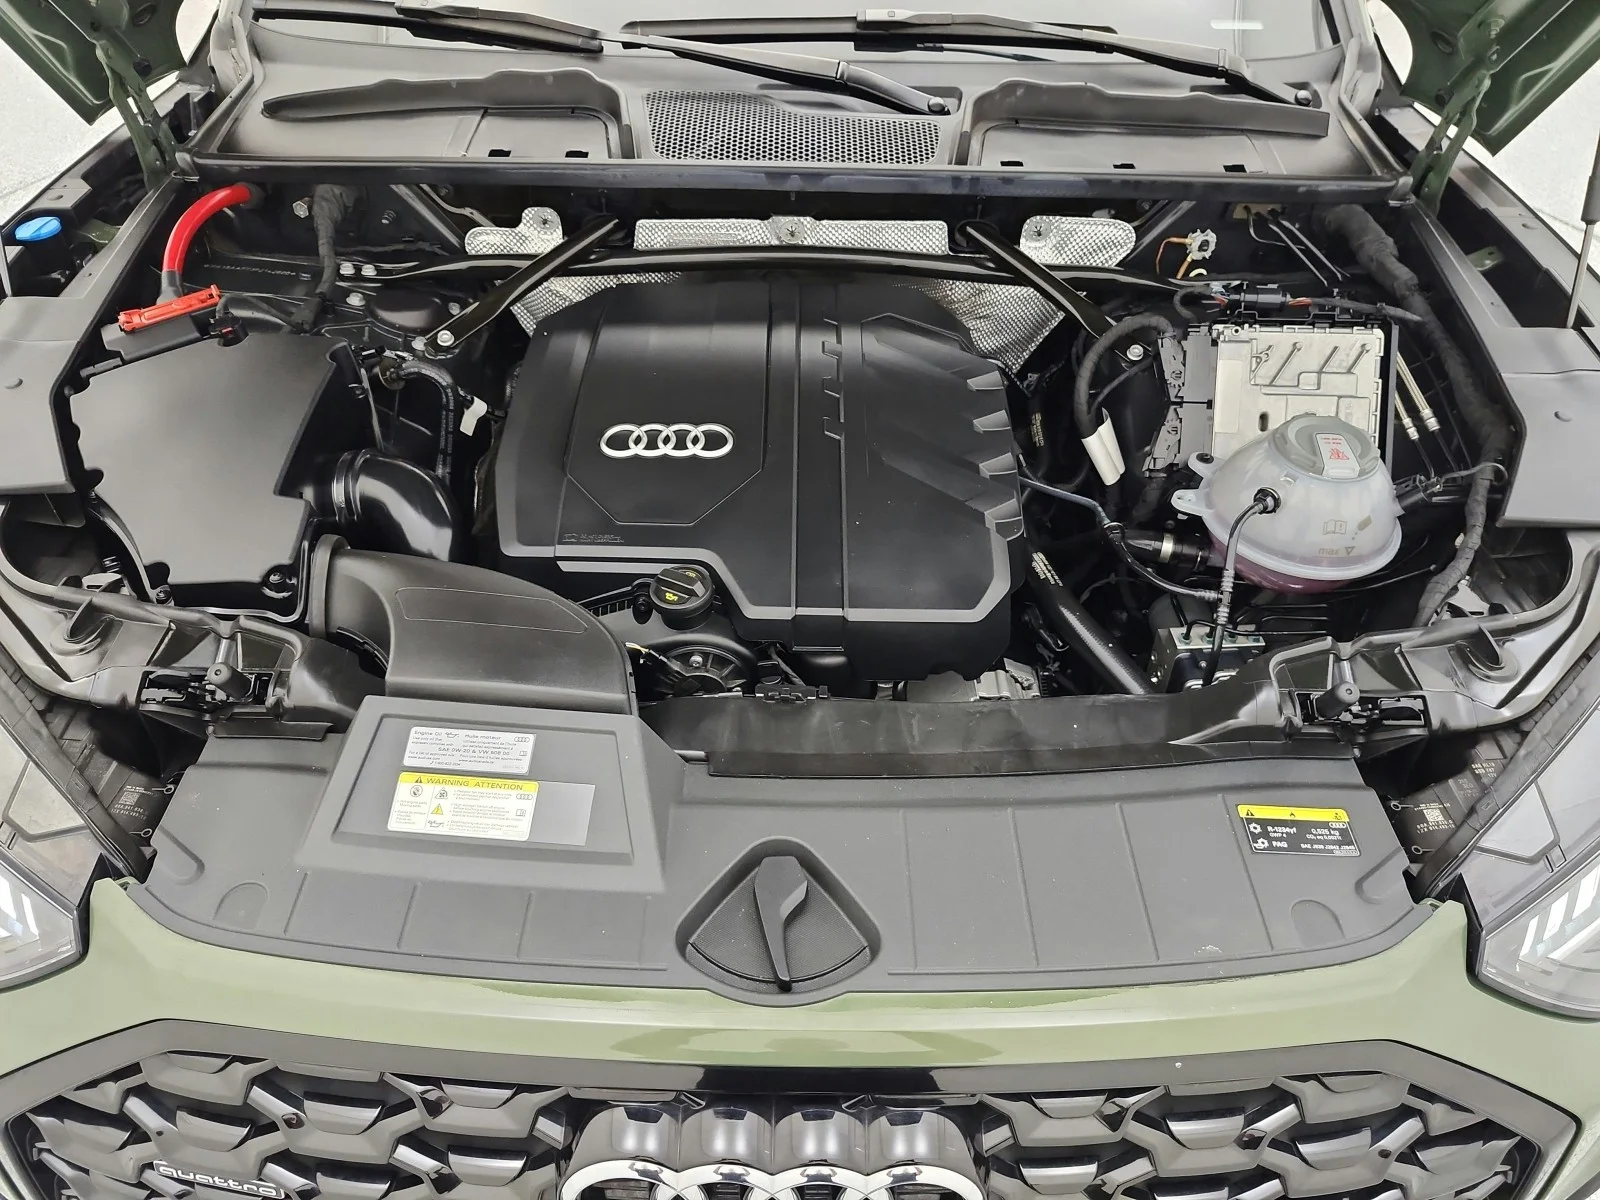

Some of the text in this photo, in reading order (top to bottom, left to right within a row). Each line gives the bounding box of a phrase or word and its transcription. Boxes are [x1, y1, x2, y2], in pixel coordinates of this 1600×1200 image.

[1318, 546, 1340, 556] max
[426, 777, 469, 787] WARNING
[474, 781, 523, 790] ATTENTION
[1271, 840, 1288, 848] PAG
[159, 1166, 277, 1197] quattro
